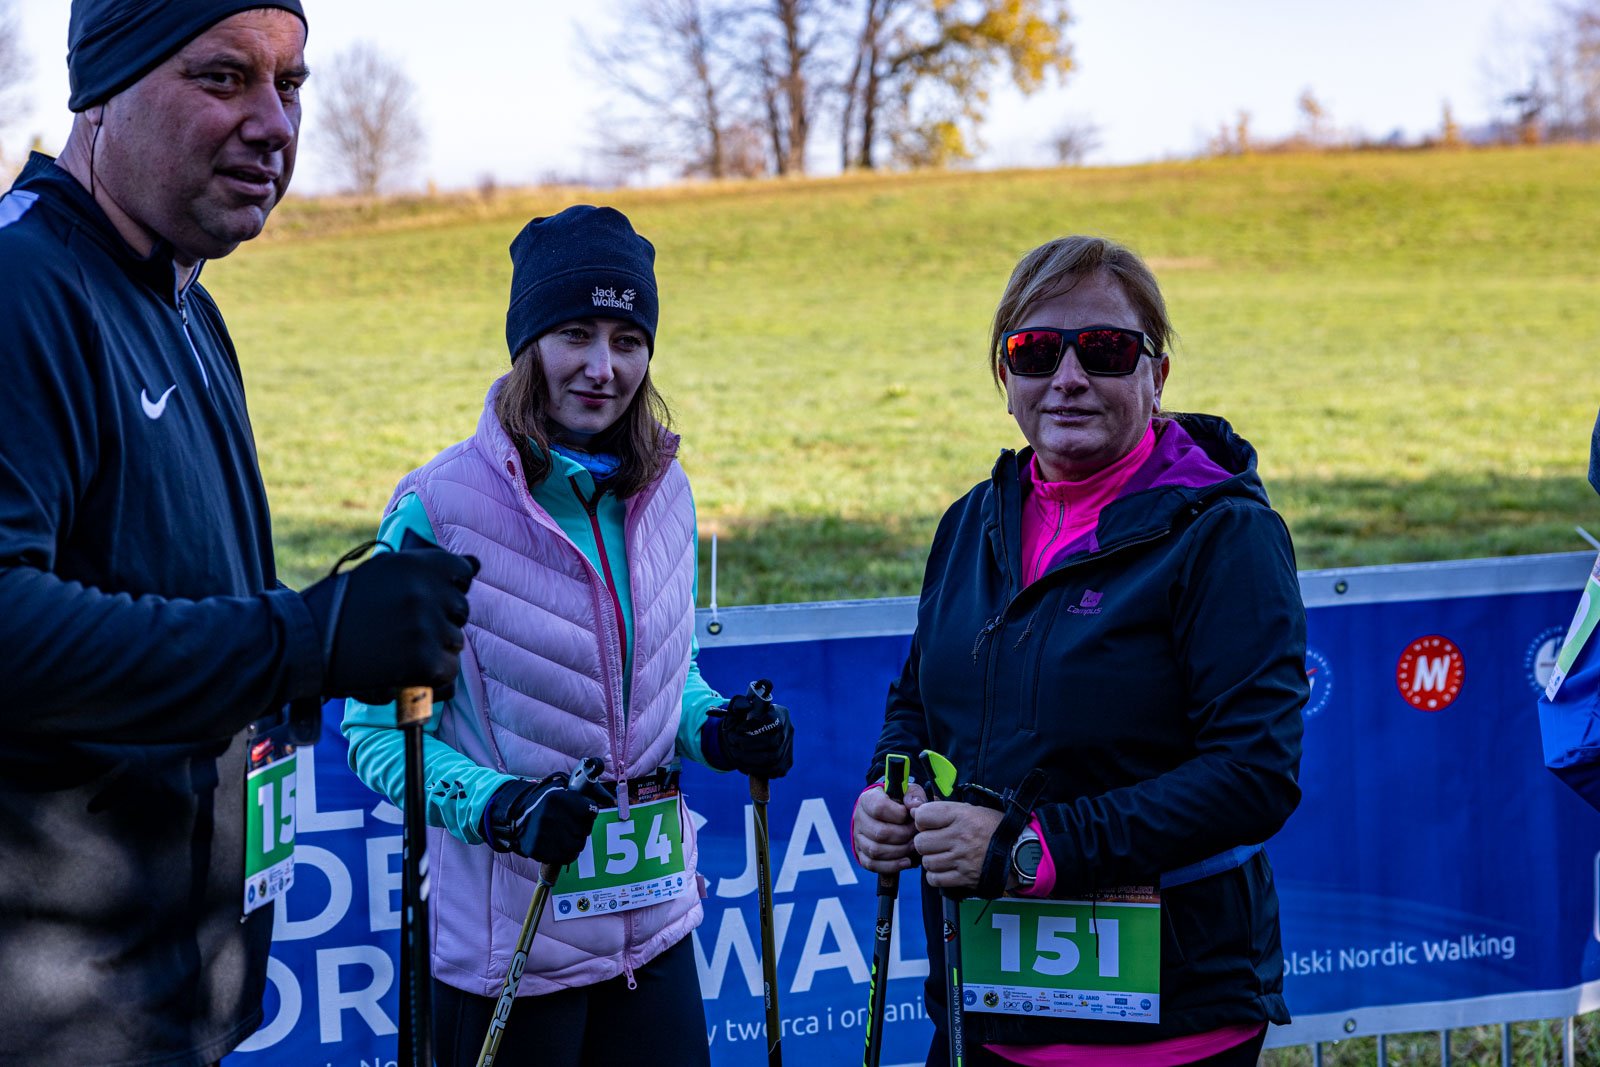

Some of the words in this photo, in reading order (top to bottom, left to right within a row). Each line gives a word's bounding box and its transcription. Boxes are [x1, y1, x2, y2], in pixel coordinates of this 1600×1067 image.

[591, 286, 617, 298] Jack
[592, 296, 633, 311] Wolfskin
[576, 813, 672, 879] 154
[992, 913, 1119, 978] 151
[1339, 941, 1417, 971] Nordic
[1423, 934, 1515, 963] Walking
[726, 1016, 819, 1042] twrca
[827, 1007, 833, 1031] i
[841, 995, 929, 1029] orani
[952, 986, 961, 1025] WALKING
[954, 1026, 963, 1057] NORDIC
